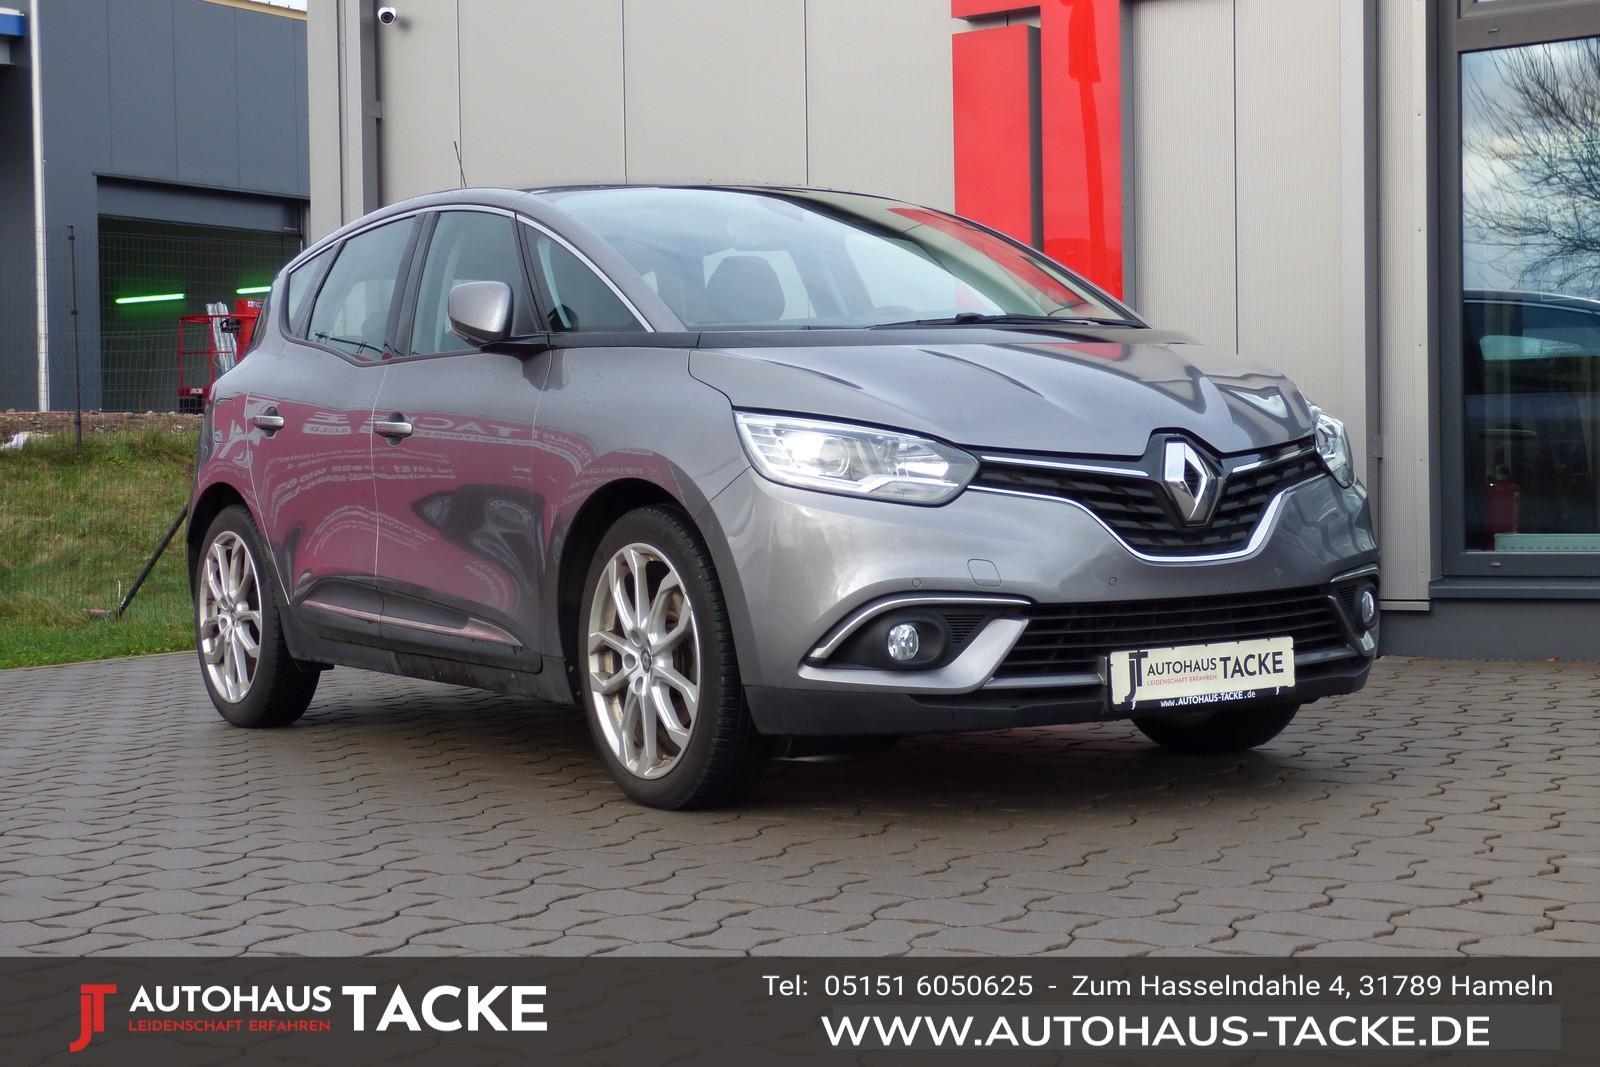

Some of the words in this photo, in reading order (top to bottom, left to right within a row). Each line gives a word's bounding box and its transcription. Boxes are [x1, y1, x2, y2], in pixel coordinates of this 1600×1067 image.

[1147, 657, 1218, 677] AUTOHAUS
[1219, 650, 1285, 679] TACKE
[1146, 677, 1188, 687] LEIDENSCHAFT
[1189, 674, 1218, 684] ERFAHREN
